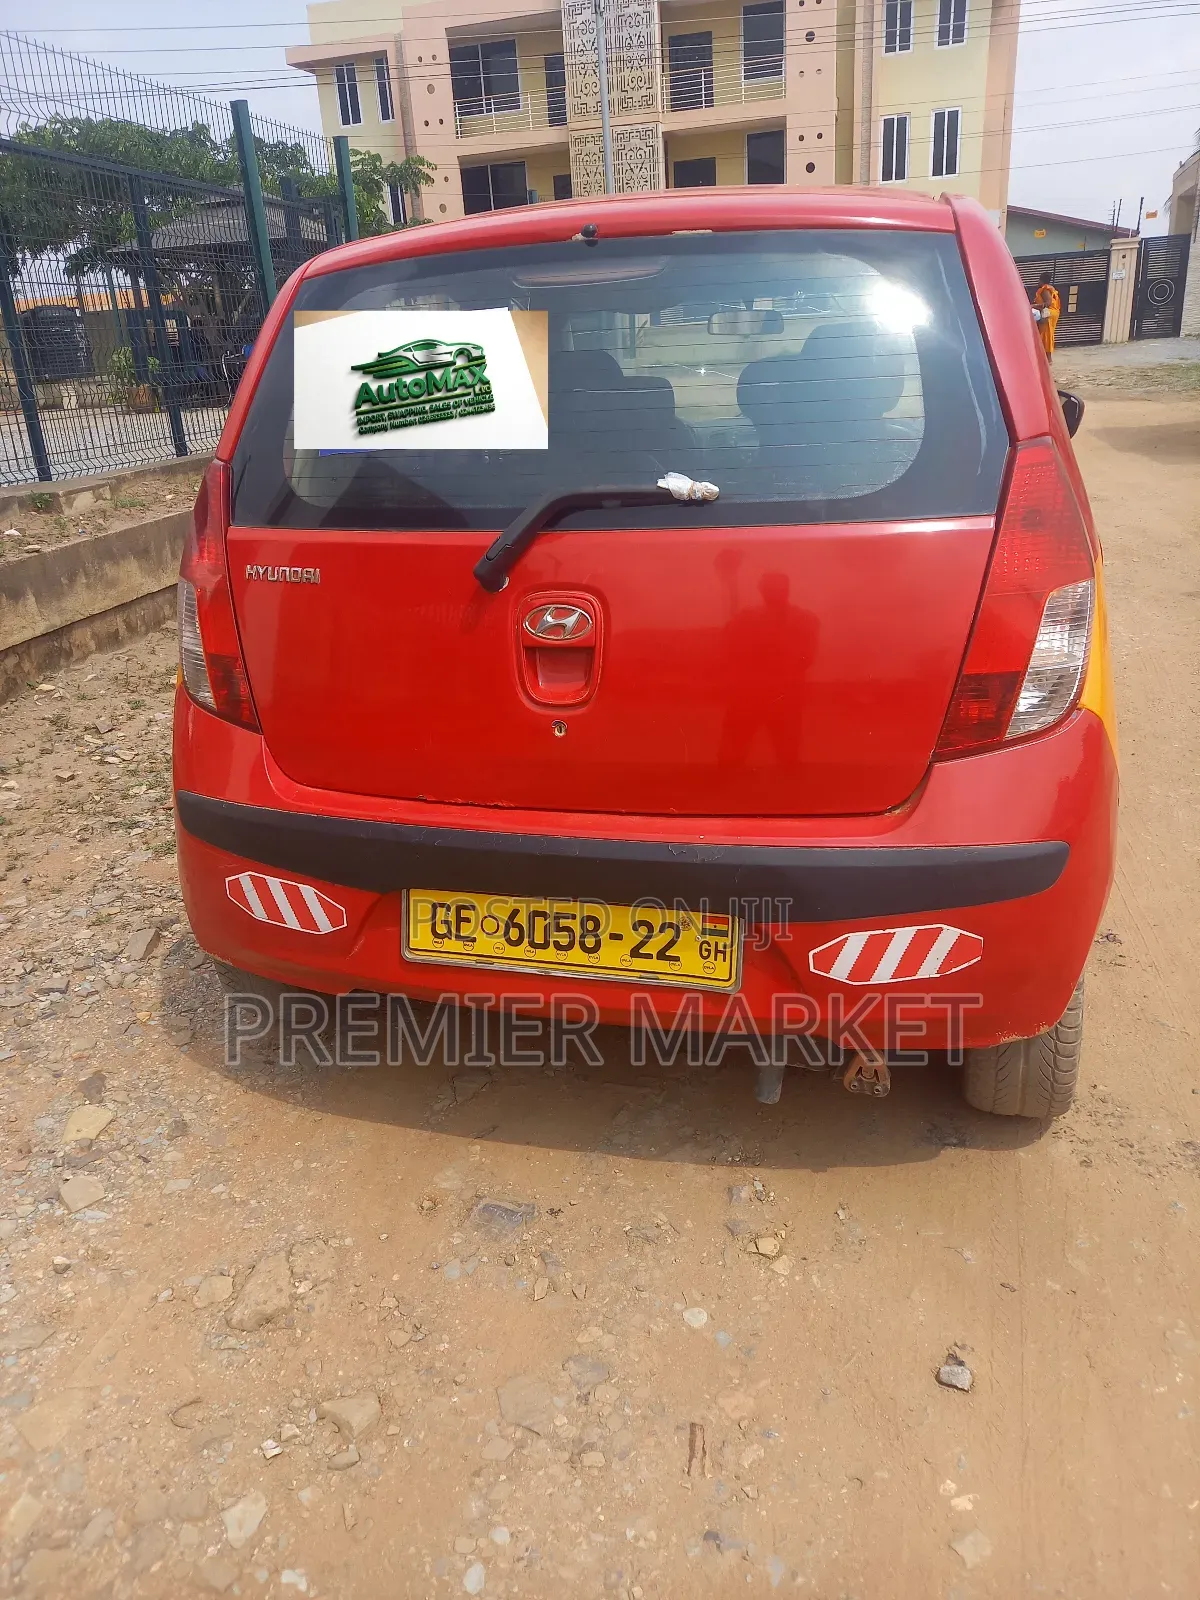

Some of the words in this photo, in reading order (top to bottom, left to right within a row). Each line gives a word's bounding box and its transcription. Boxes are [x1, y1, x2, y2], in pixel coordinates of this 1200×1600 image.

[245, 564, 321, 584] HYUNDAI
[431, 902, 477, 942] GE
[699, 940, 727, 962] GH
